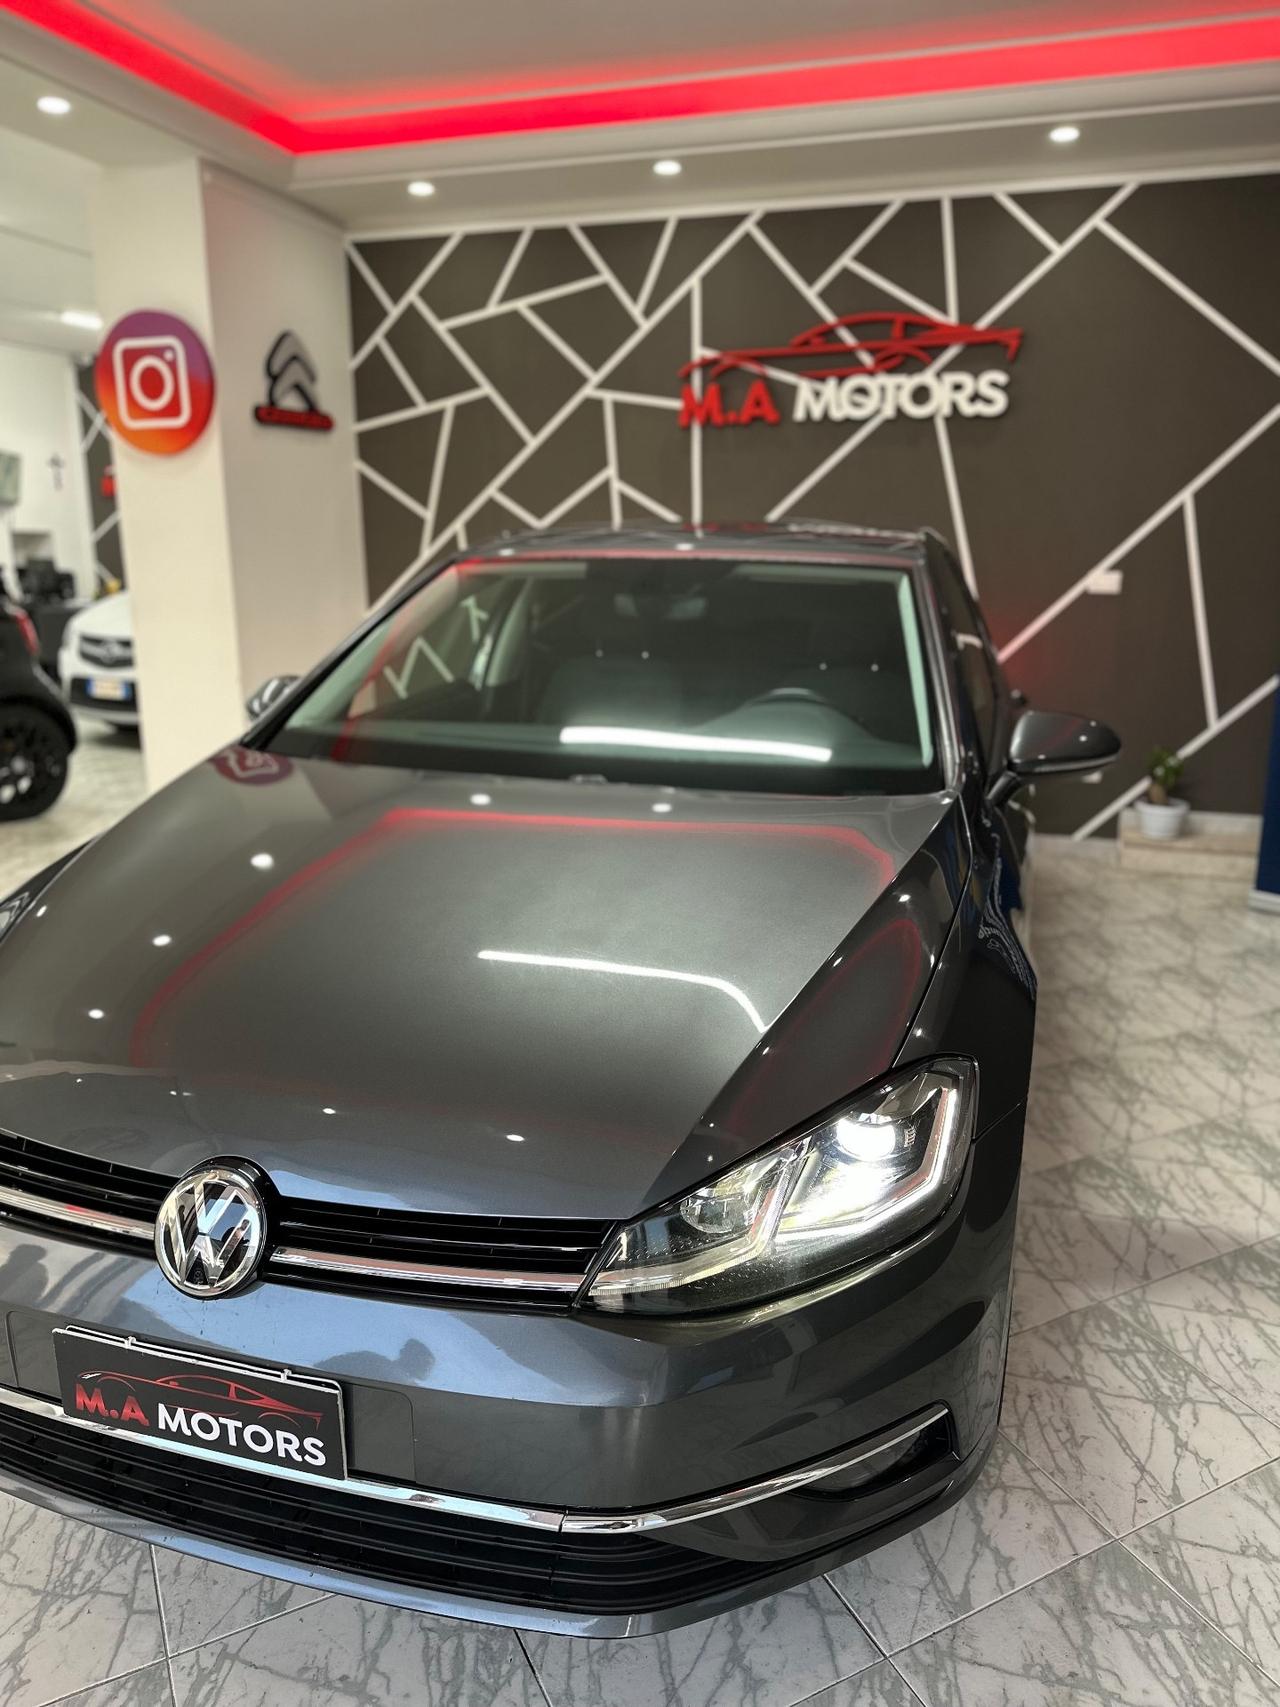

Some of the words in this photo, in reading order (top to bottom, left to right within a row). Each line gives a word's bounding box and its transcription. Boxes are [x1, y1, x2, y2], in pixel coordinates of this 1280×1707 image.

[679, 380, 780, 428] M.A
[793, 369, 1010, 423] MOTORS
[75, 1383, 150, 1427] M.A
[158, 1403, 326, 1466] MOTORS
